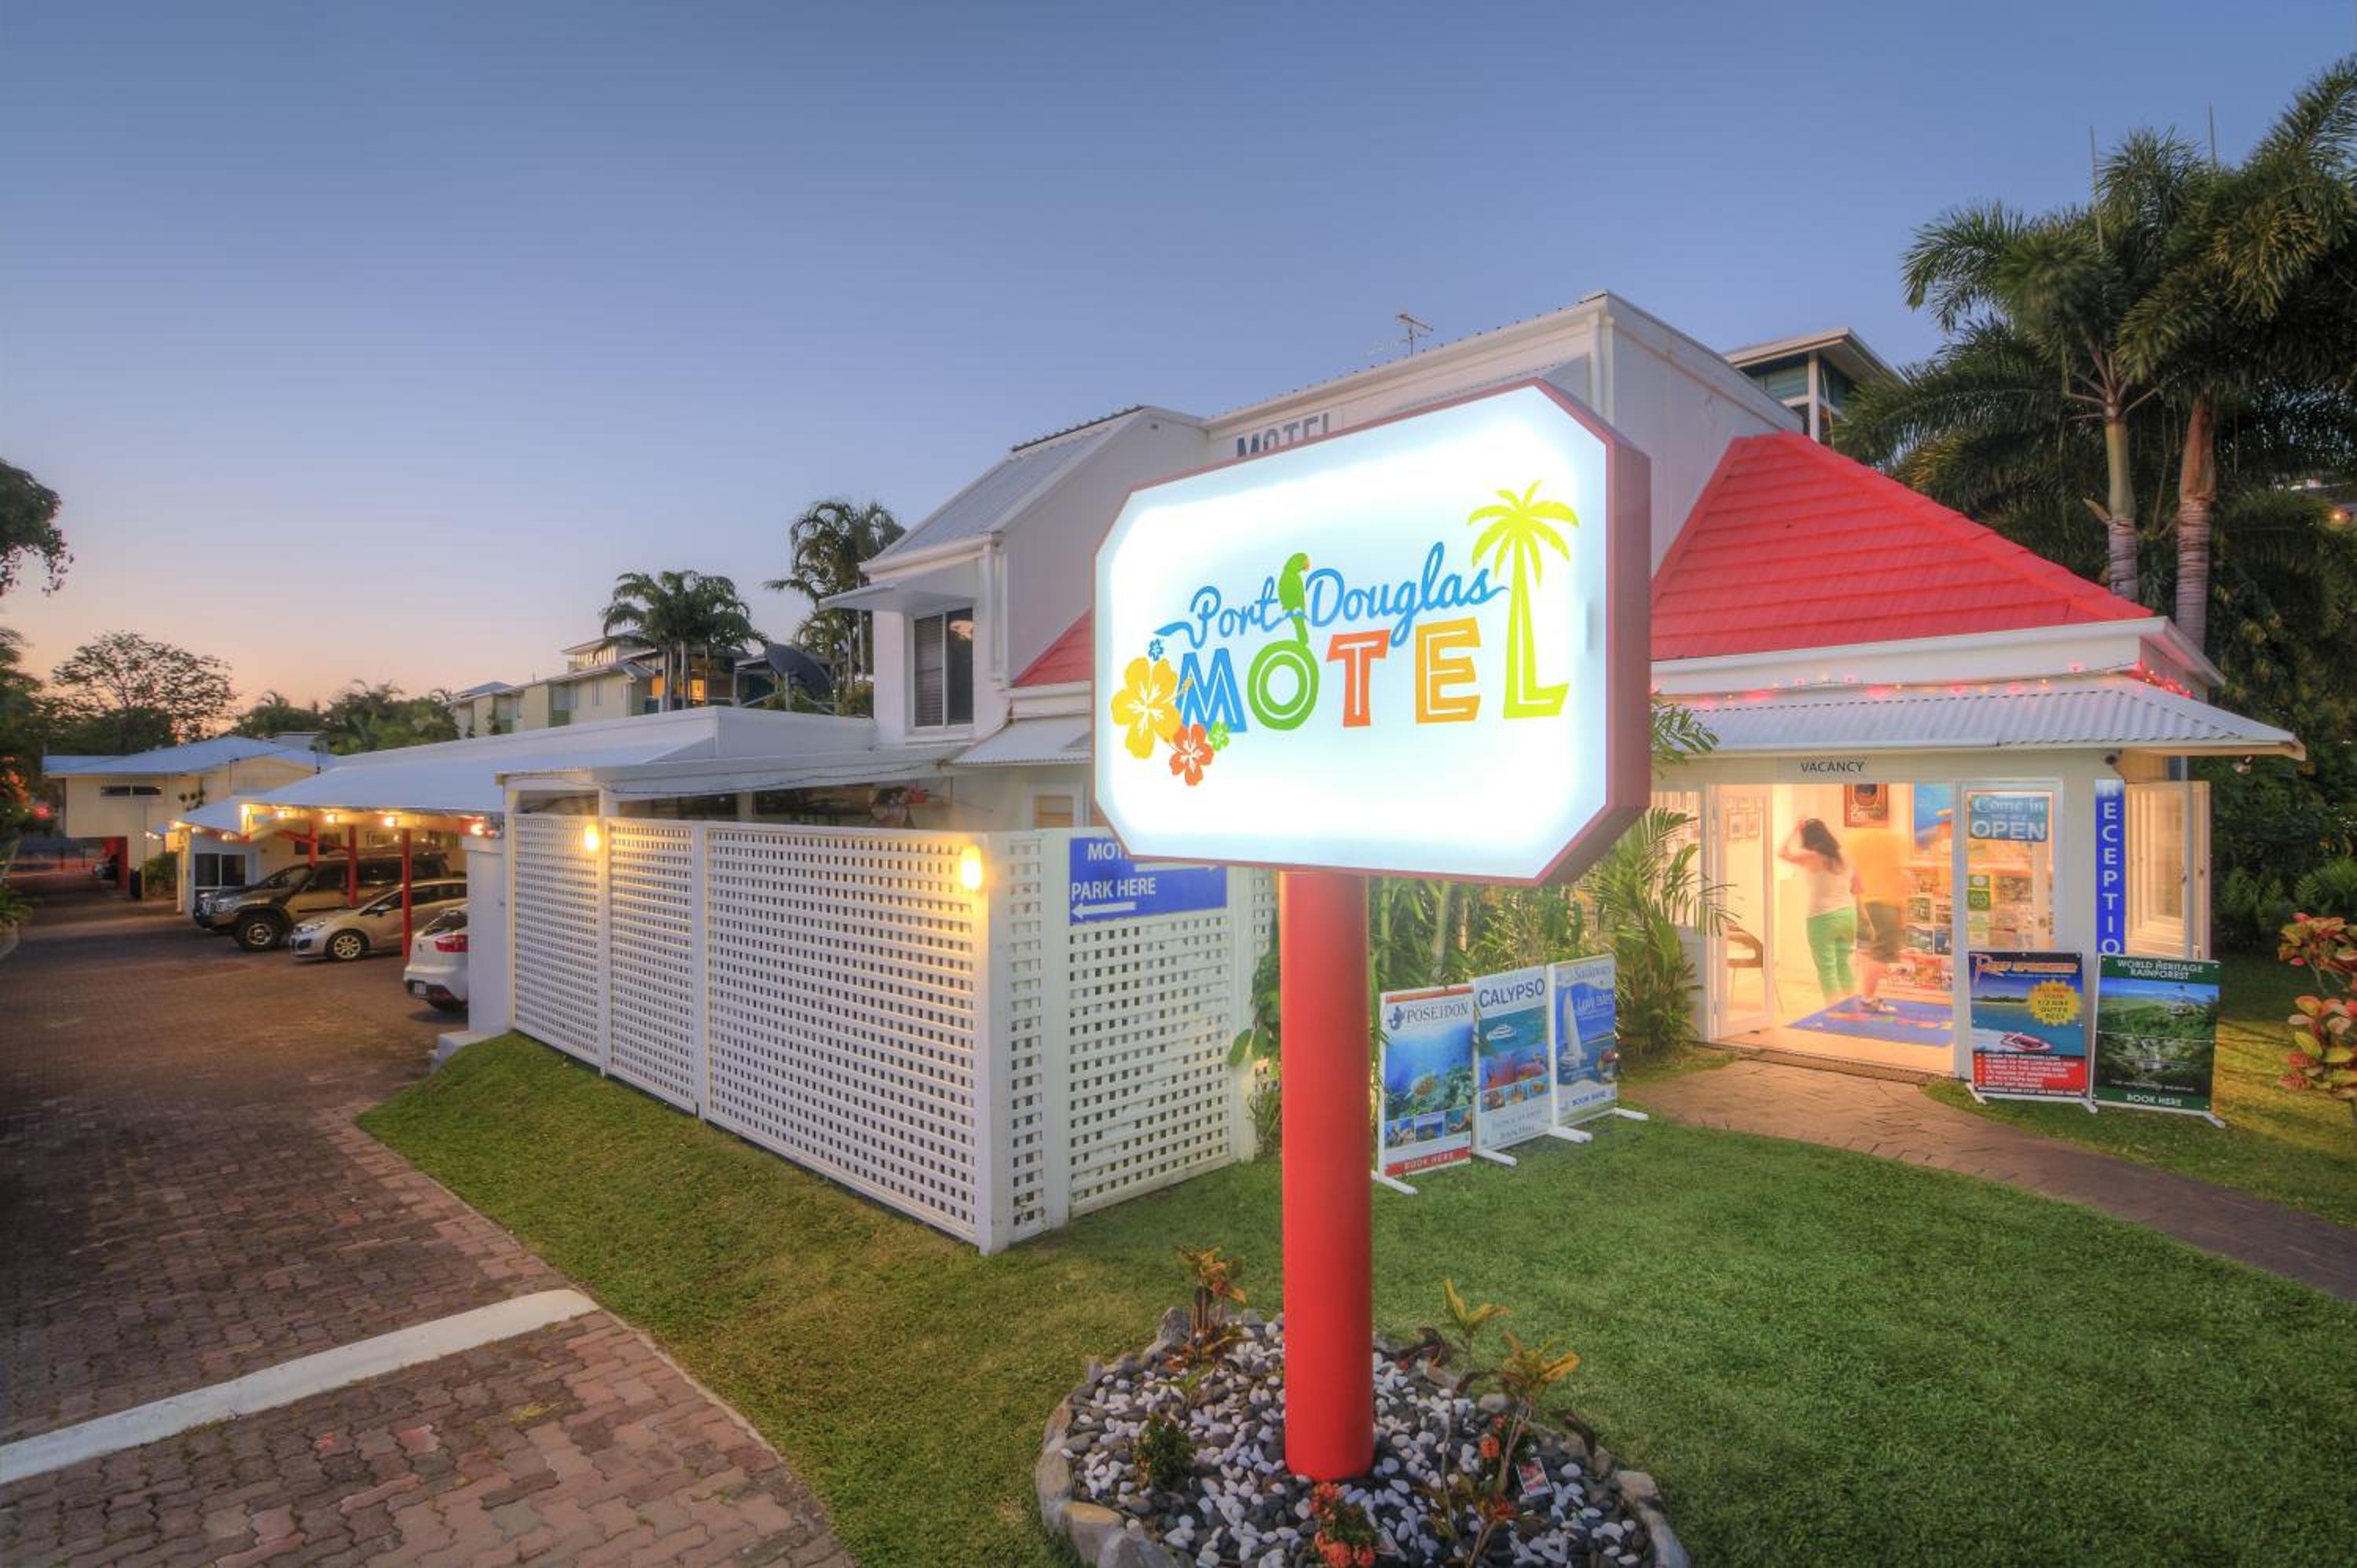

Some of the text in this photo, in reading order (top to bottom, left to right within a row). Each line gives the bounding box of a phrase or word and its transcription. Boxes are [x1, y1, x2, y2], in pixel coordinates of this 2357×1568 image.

[1153, 541, 1508, 649] Port Douglas
[1175, 542, 1570, 733] MOTEL
[1800, 760, 1865, 773] VACANCY
[1971, 820, 2046, 841] OPEN
[1071, 877, 1157, 902] PARK HERE
[2117, 959, 2205, 973] WORLD HERITAGE
[2130, 969, 2190, 980] RAINFOREST
[1479, 978, 1545, 1008] CALYPSO
[1407, 1002, 1468, 1023] POSEIDON
[2127, 1094, 2182, 1107] BOOK HERE
